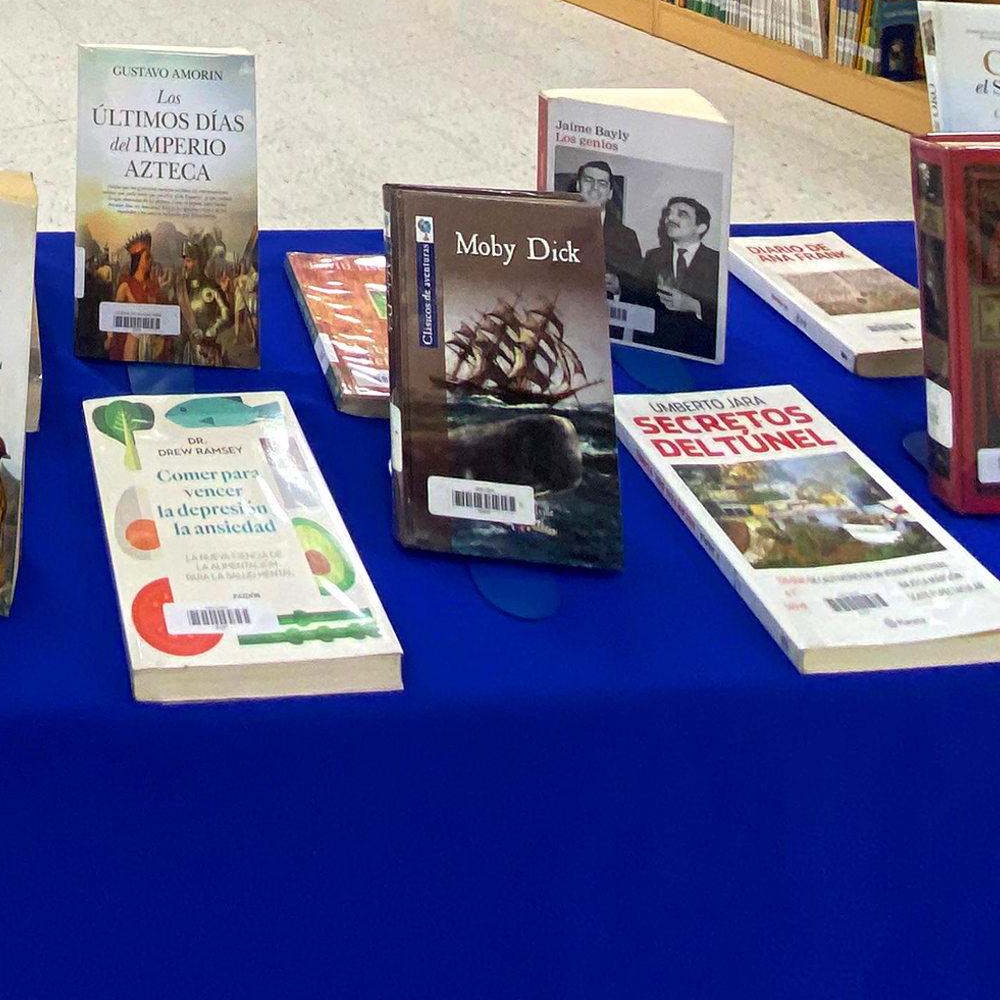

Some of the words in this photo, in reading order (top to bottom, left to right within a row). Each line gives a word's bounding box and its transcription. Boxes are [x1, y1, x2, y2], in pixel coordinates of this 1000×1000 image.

[112, 66, 169, 78] GUSTAVO
[172, 69, 223, 81] AMORIN
[975, 79, 988, 94] el
[157, 89, 181, 104] Los
[92, 104, 190, 130] ÚLTIMOS
[196, 110, 245, 133] DÍAS
[555, 120, 592, 134] Jaime
[595, 126, 630, 142] Bayly
[109, 136, 131, 151] del
[135, 135, 227, 157] IMPERIO
[555, 132, 576, 144] Los
[578, 136, 619, 151] genios
[124, 160, 211, 181] AZTECA
[455, 231, 516, 265] Moby
[527, 236, 582, 263] Dick
[759, 253, 795, 263] ANA
[796, 251, 850, 262] FRANK
[422, 244, 432, 287] aventuras
[422, 288, 432, 301] de
[650, 399, 726, 414] UMBERTO
[728, 395, 766, 409] JARA
[633, 406, 813, 435] SECRETOS
[158, 447, 193, 457] DREW
[195, 445, 243, 456] RAMSEY
[650, 435, 724, 458] DEL
[722, 427, 837, 455] TÚNEL
[156, 469, 218, 483] Comer
[221, 469, 260, 483] para
[183, 486, 243, 498] vencer
[157, 505, 174, 518] la
[174, 522, 191, 536] la
[194, 519, 277, 535] ansiedad
